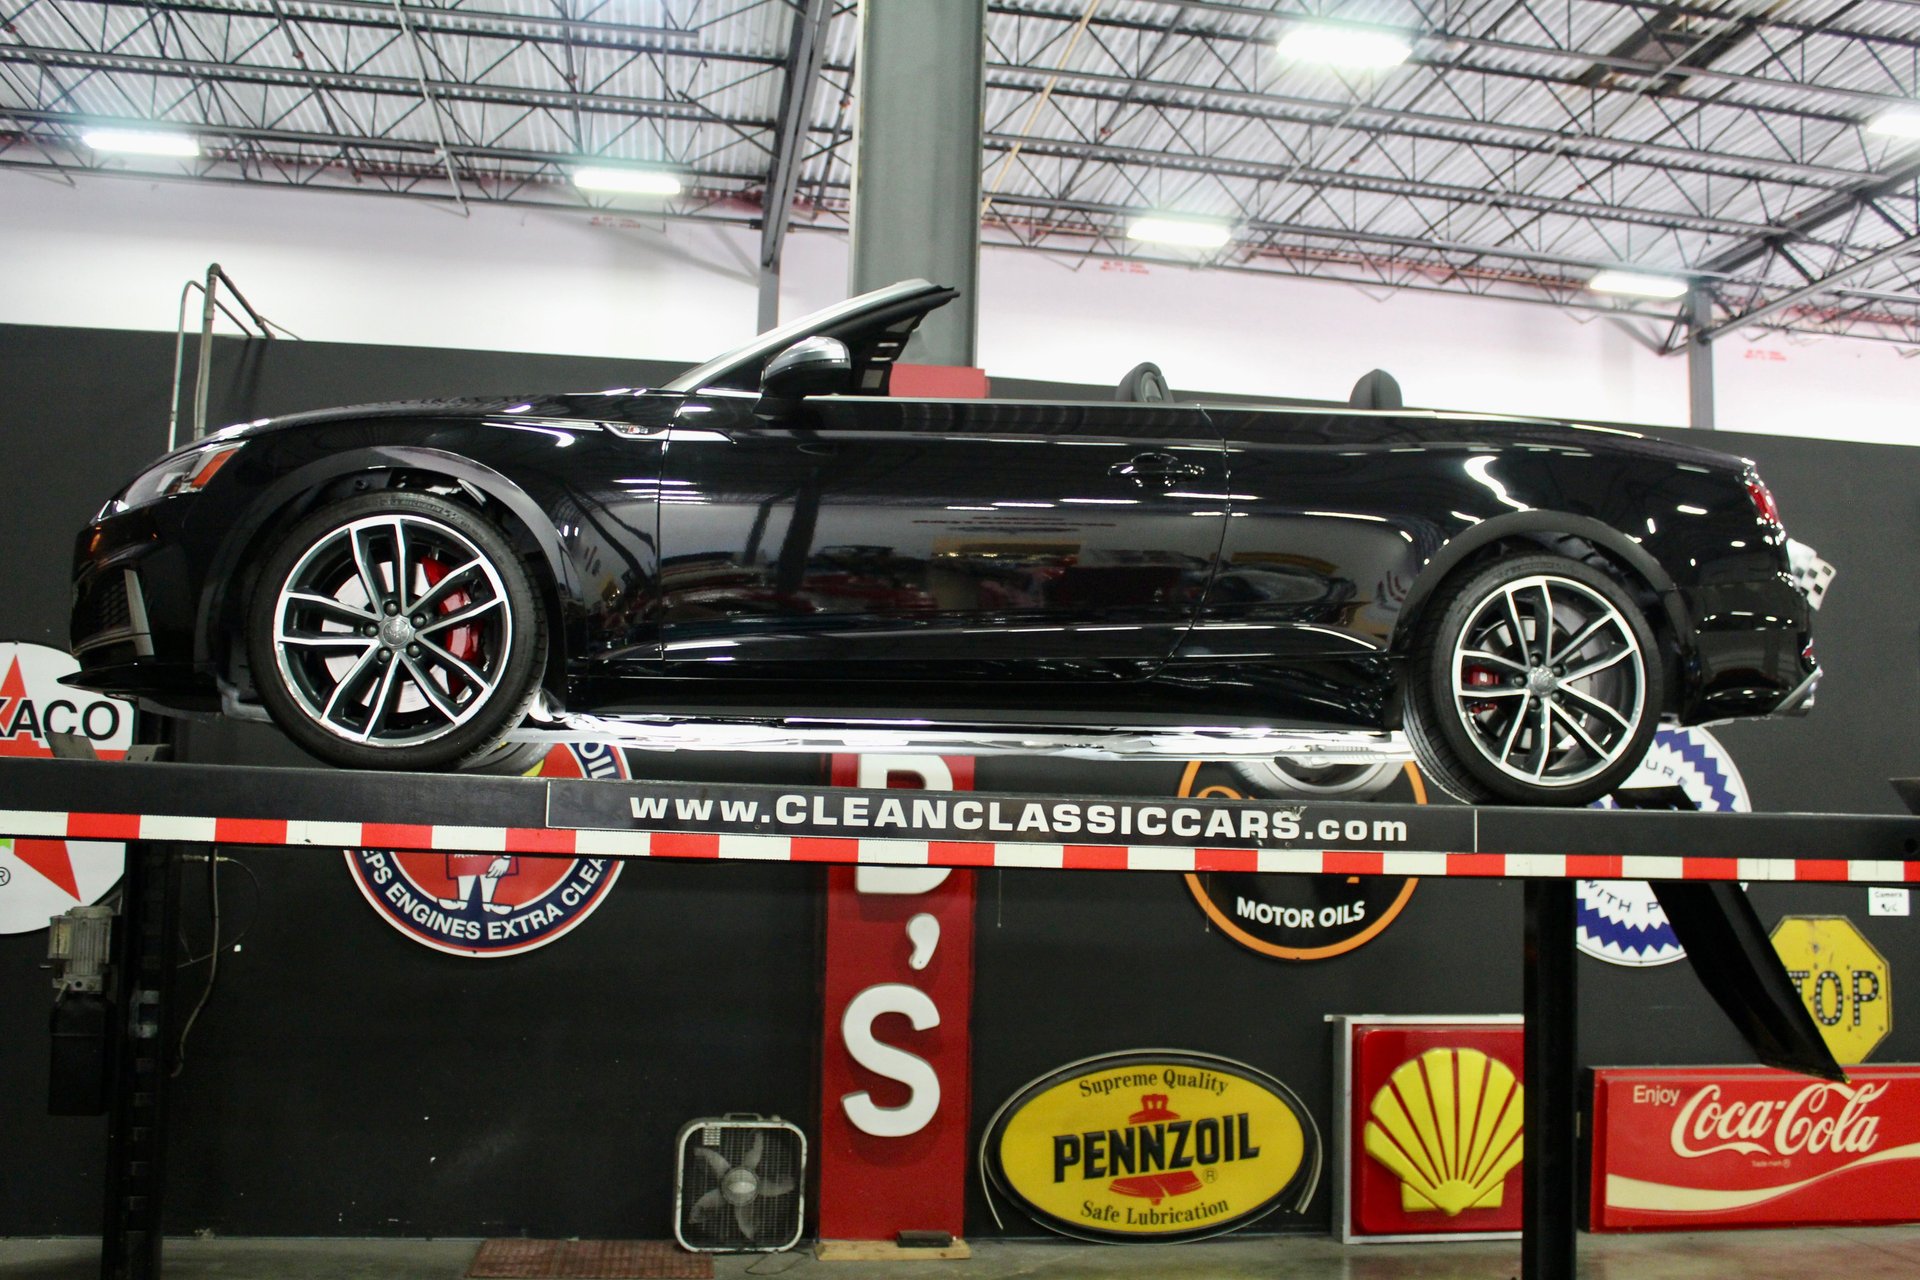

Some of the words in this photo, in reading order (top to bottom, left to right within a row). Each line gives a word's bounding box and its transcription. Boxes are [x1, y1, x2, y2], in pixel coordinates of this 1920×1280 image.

[0, 698, 120, 741] ACO
[629, 794, 1408, 842] www.CLEANCLASSICCARS.com
[385, 882, 481, 940] ENGINES
[487, 902, 564, 940] EXTRA
[1236, 896, 1315, 929] MOTOR
[1318, 901, 1366, 929] OILS
[1079, 1073, 1158, 1098] Supreme
[1162, 1068, 1229, 1097] Quality
[1633, 1084, 1681, 1107] Enjoy
[1670, 1080, 1891, 1159] Coca-Cola
[1053, 1112, 1260, 1184] PENNZOIL
[1080, 1199, 1121, 1223] Safe
[1125, 1199, 1230, 1226] Lubrication
